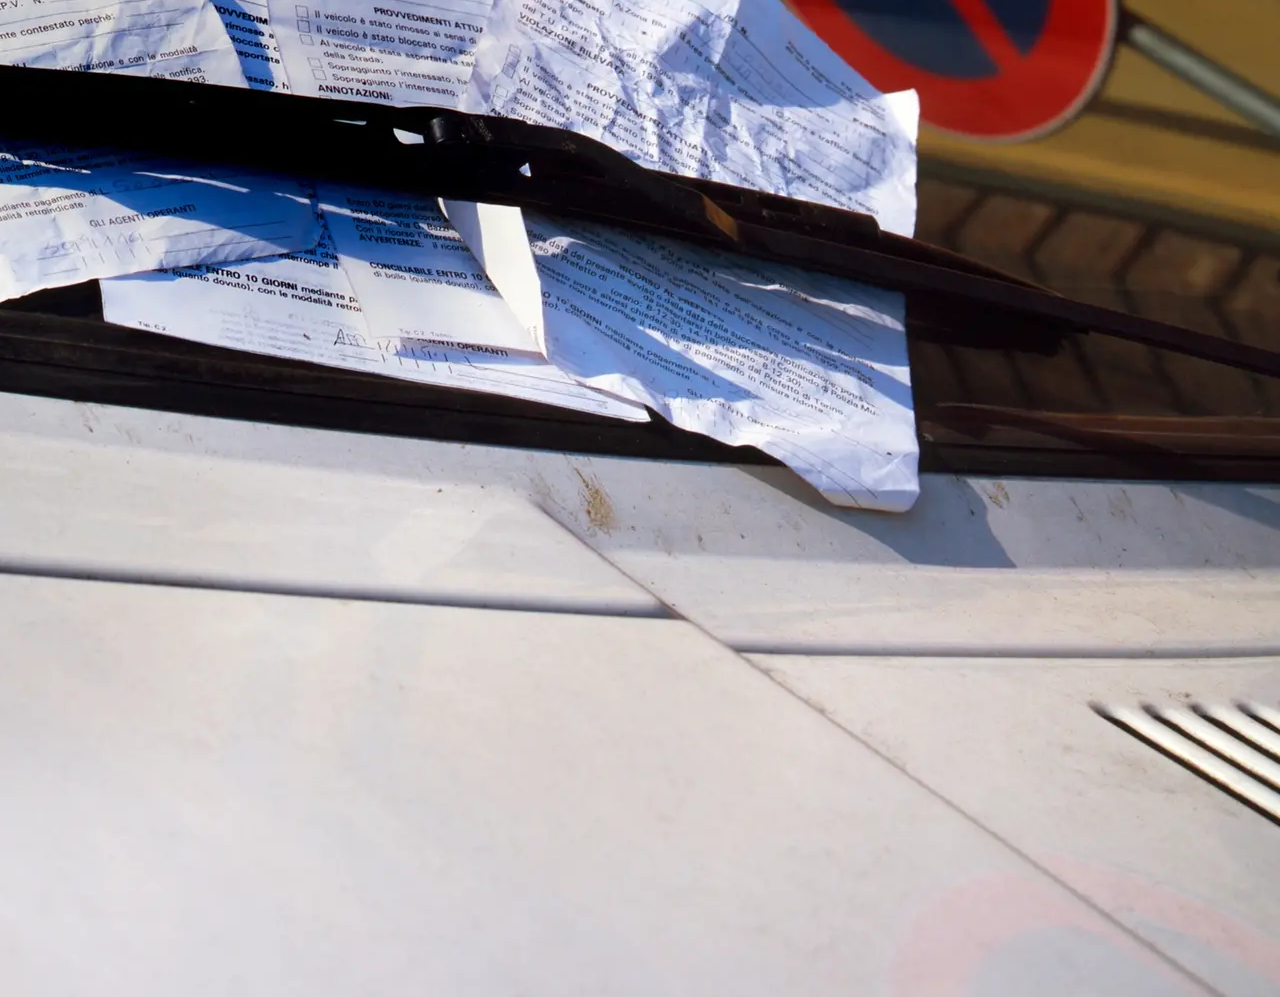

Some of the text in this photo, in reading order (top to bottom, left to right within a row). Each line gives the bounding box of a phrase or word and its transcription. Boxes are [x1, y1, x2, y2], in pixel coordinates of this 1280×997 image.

[374, 7, 451, 27] PROVVEDIMENTI
[316, 25, 456, 52] Il veicolo è stato bloccato con
[318, 85, 392, 101] ANNOTAZIONI:
[33, 192, 86, 206] pagamento
[89, 205, 196, 228] GLI AGENTI OPERANTI
[370, 262, 482, 281] CONCILIABILE ENTRO 10
[209, 265, 345, 301] ENTRO 10 GIORNI mediante
